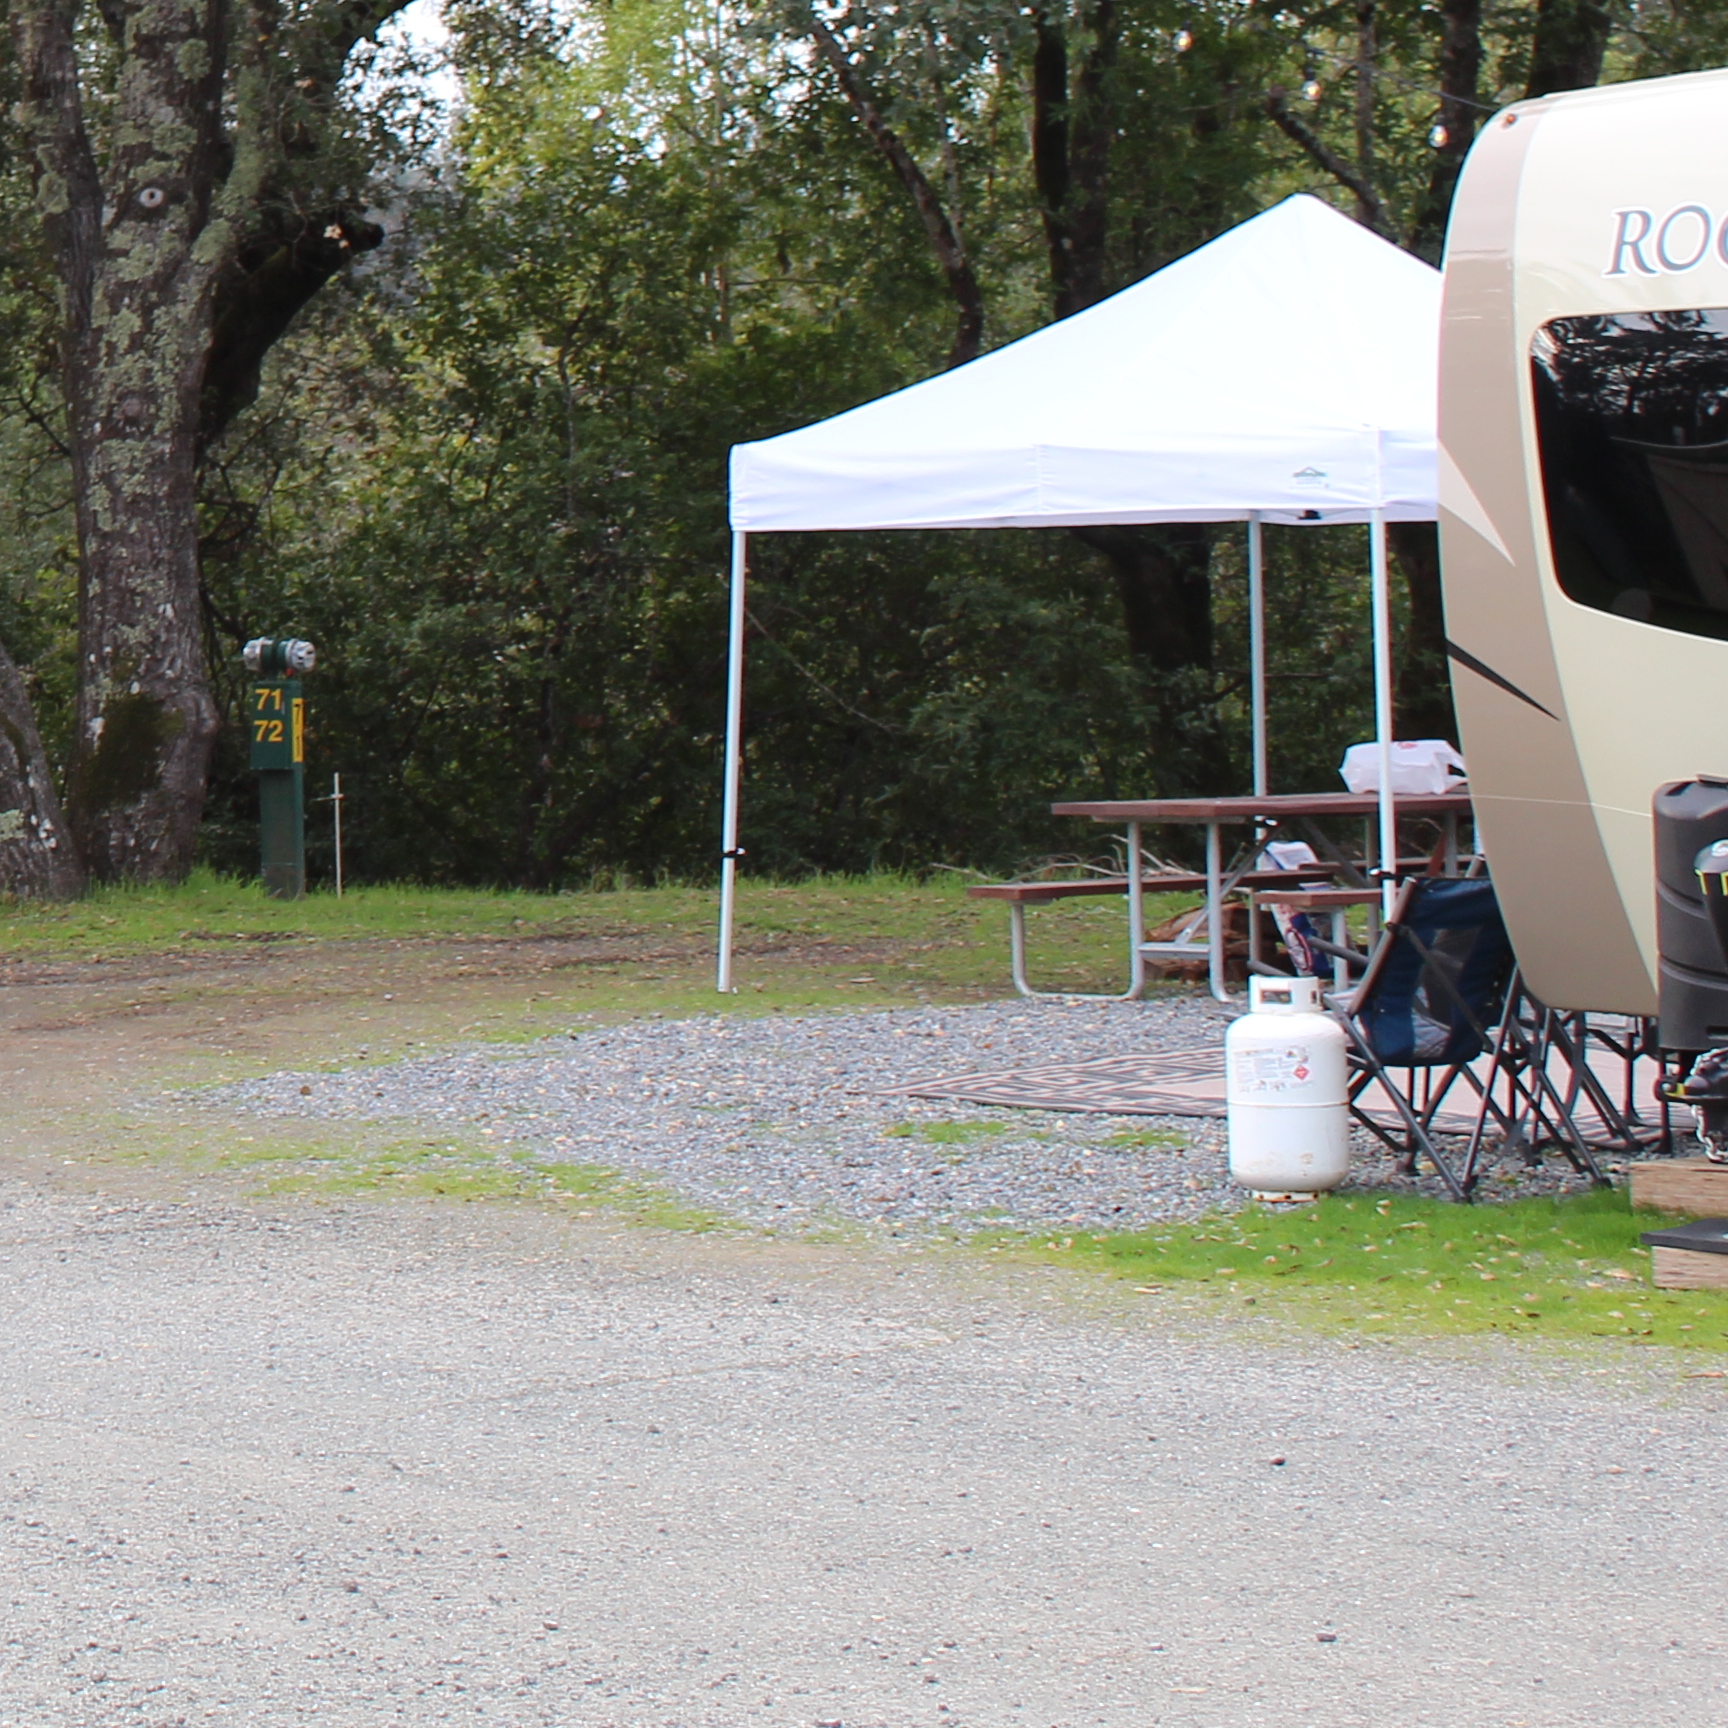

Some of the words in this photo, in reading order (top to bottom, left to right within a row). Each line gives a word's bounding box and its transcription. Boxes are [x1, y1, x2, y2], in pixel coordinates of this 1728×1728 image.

[1602, 203, 1728, 275] RO
[255, 688, 283, 711] 71
[253, 720, 285, 743] 72
